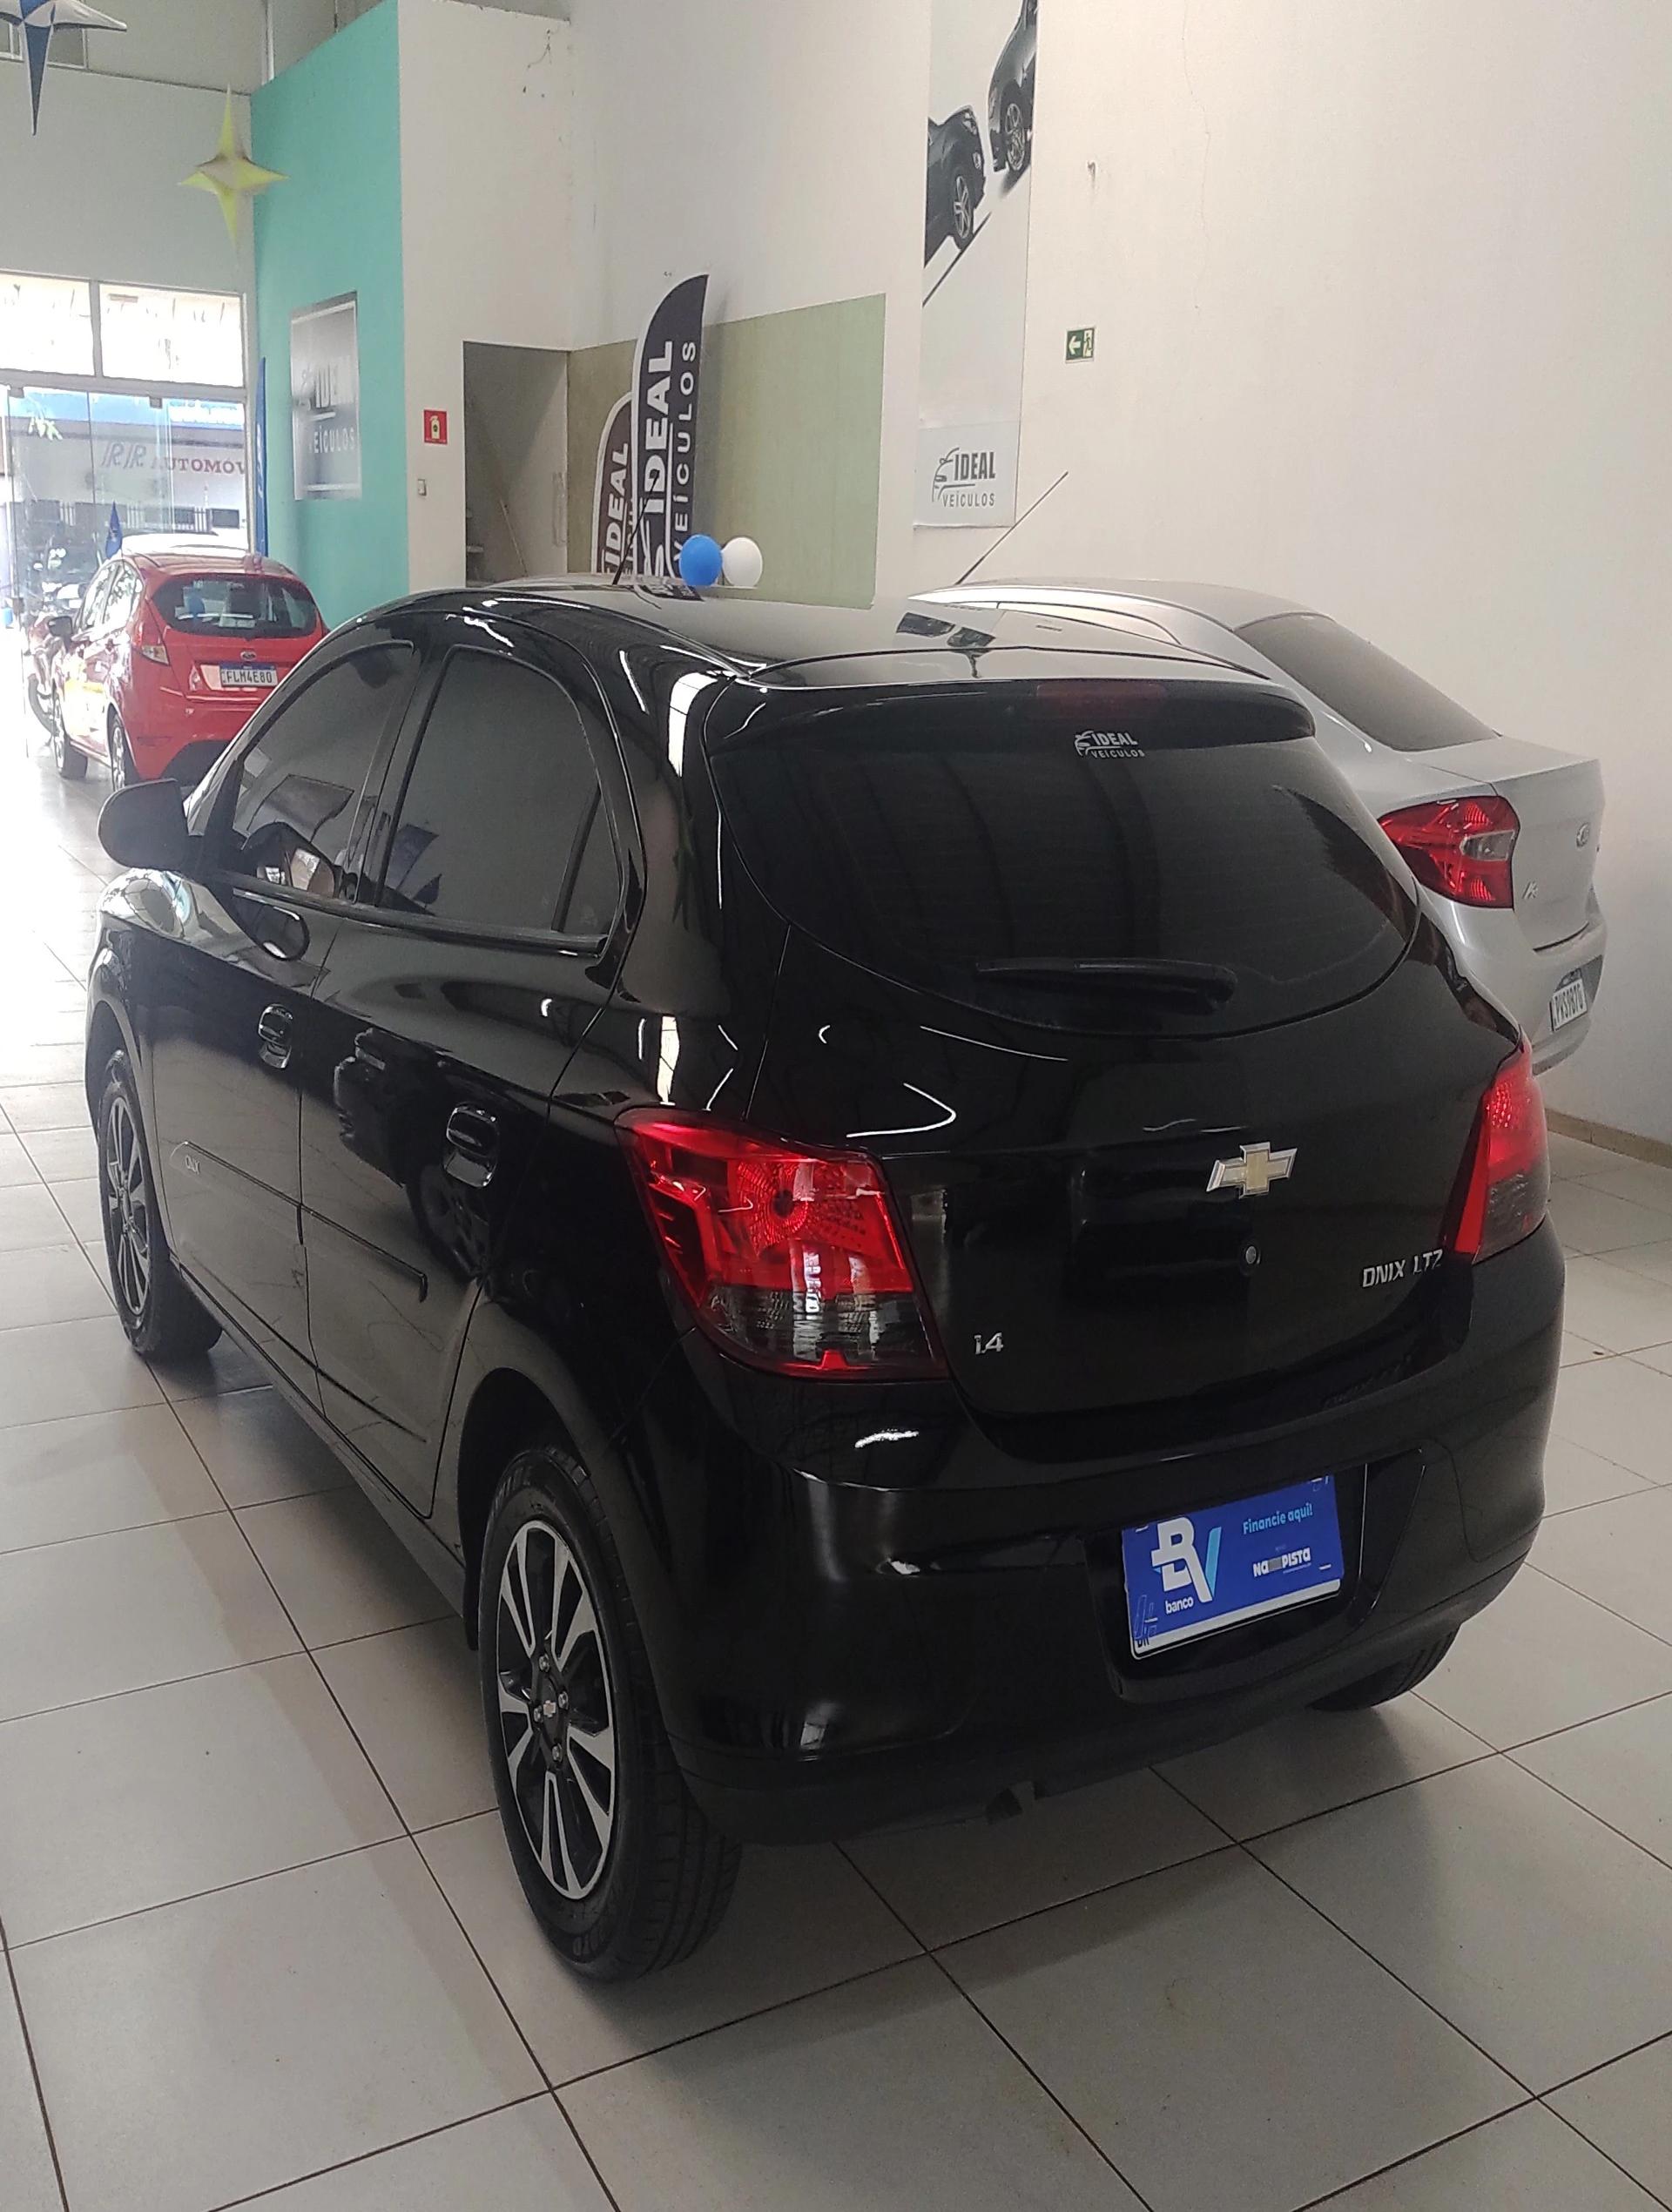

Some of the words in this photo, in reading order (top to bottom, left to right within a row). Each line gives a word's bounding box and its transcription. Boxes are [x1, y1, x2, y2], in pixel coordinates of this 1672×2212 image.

[644, 341, 672, 514] IDEAL
[954, 451, 996, 481] IDEAL
[604, 443, 628, 567] IDEAL
[1090, 732, 1138, 745] IDEAL
[1362, 1259, 1406, 1287] ONIX
[1412, 1249, 1443, 1275] LTZ
[1243, 1511, 1286, 1534] Financie
[1288, 1502, 1313, 1522] aqui!
[1165, 1596, 1194, 1615] banco
